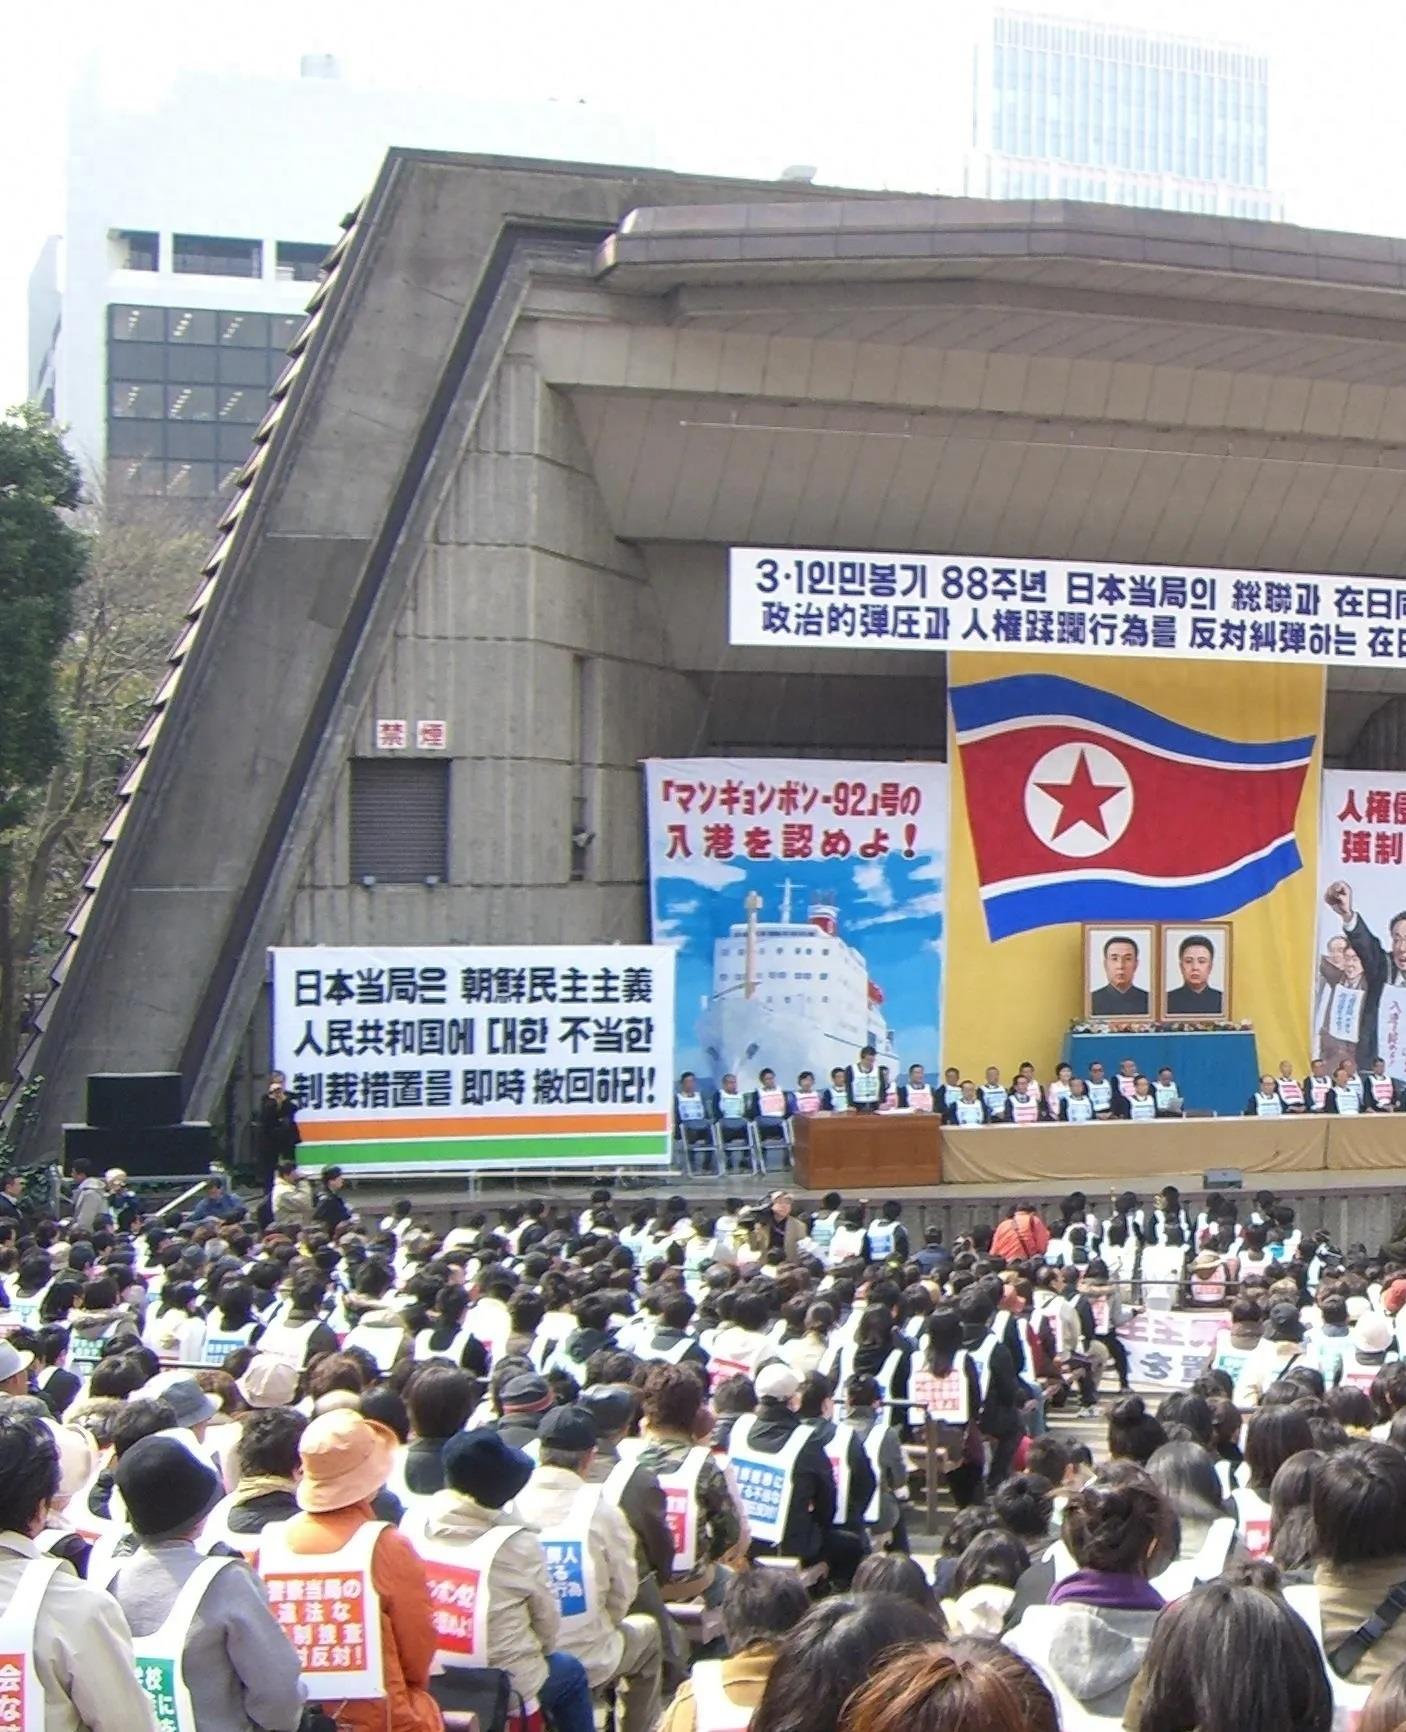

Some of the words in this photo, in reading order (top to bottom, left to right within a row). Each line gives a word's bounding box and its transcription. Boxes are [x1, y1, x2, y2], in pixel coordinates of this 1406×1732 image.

[941, 566, 1048, 603] 88주년
[1065, 571, 1217, 612] 日本当局의
[761, 601, 951, 642] 政治的弾圧과
[666, 823, 917, 859] 入港を認めよ！
[294, 965, 447, 1007] 日本当局은
[461, 965, 653, 1005] 朝鮮民主主義
[293, 1016, 474, 1057] 人民共和国에
[486, 1017, 549, 1056] 대한
[558, 1016, 653, 1055] 不当한
[294, 1068, 453, 1111] 制裁措置를
[461, 1067, 525, 1107] 即時
[533, 1066, 656, 1107] 撤回하라!
